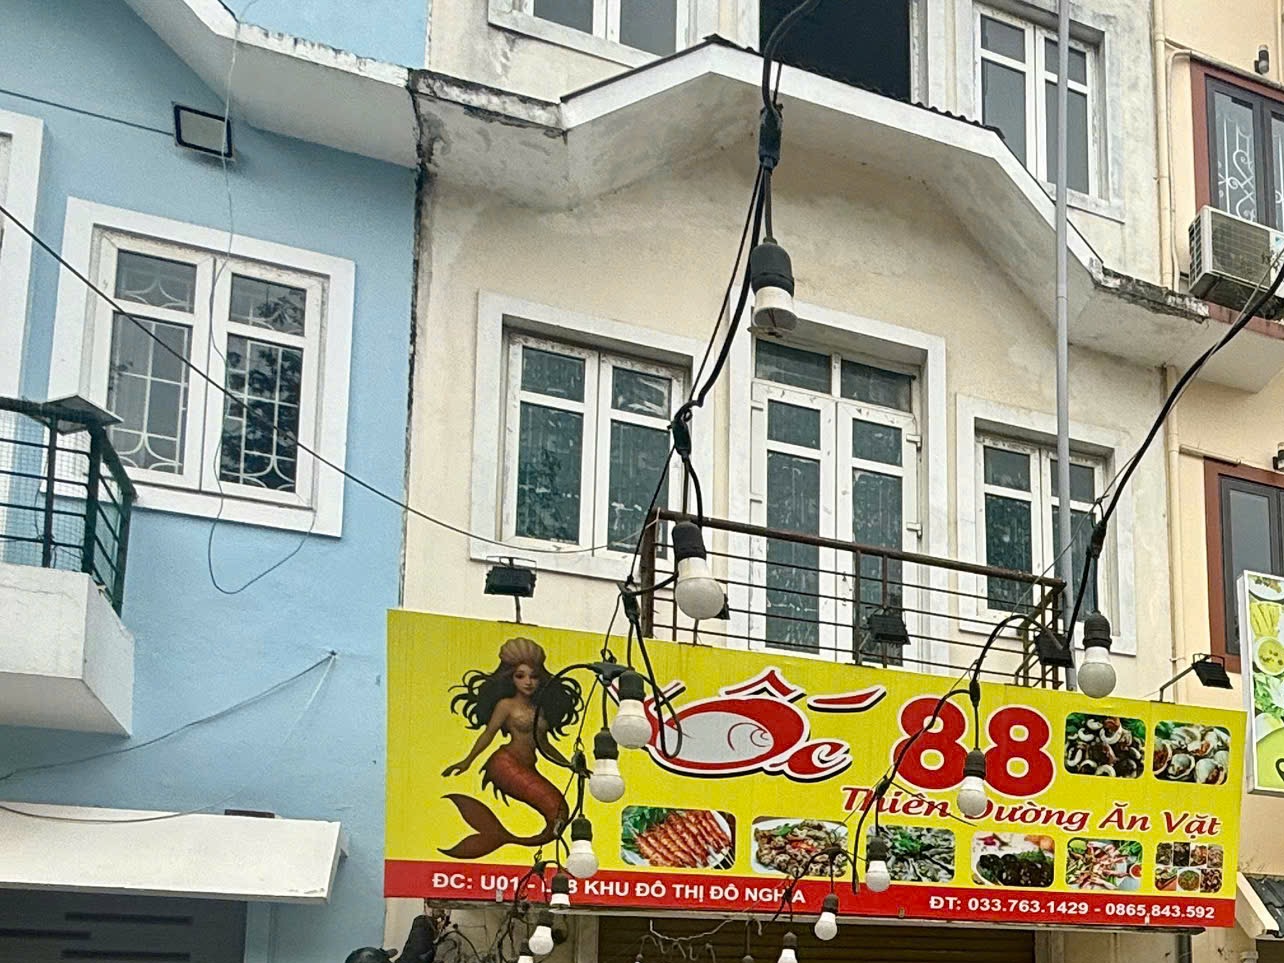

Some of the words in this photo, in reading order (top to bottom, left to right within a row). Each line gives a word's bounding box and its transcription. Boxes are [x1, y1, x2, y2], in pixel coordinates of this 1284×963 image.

[891, 694, 1057, 799] 88
[841, 785, 950, 821] Thiên
[1099, 802, 1152, 833] Ăn
[1163, 810, 1222, 840] Vặt
[431, 872, 474, 890] ĐC:
[480, 874, 520, 893] U01
[584, 879, 630, 896] KHU
[635, 882, 667, 898] ĐÔ
[672, 883, 704, 903] THỊ
[709, 882, 739, 901] ĐÔ
[744, 886, 806, 904] NGHA
[928, 895, 962, 912] ĐT:
[967, 897, 1089, 915] 033.763.1429
[1104, 901, 1215, 920] 0865.843.592
